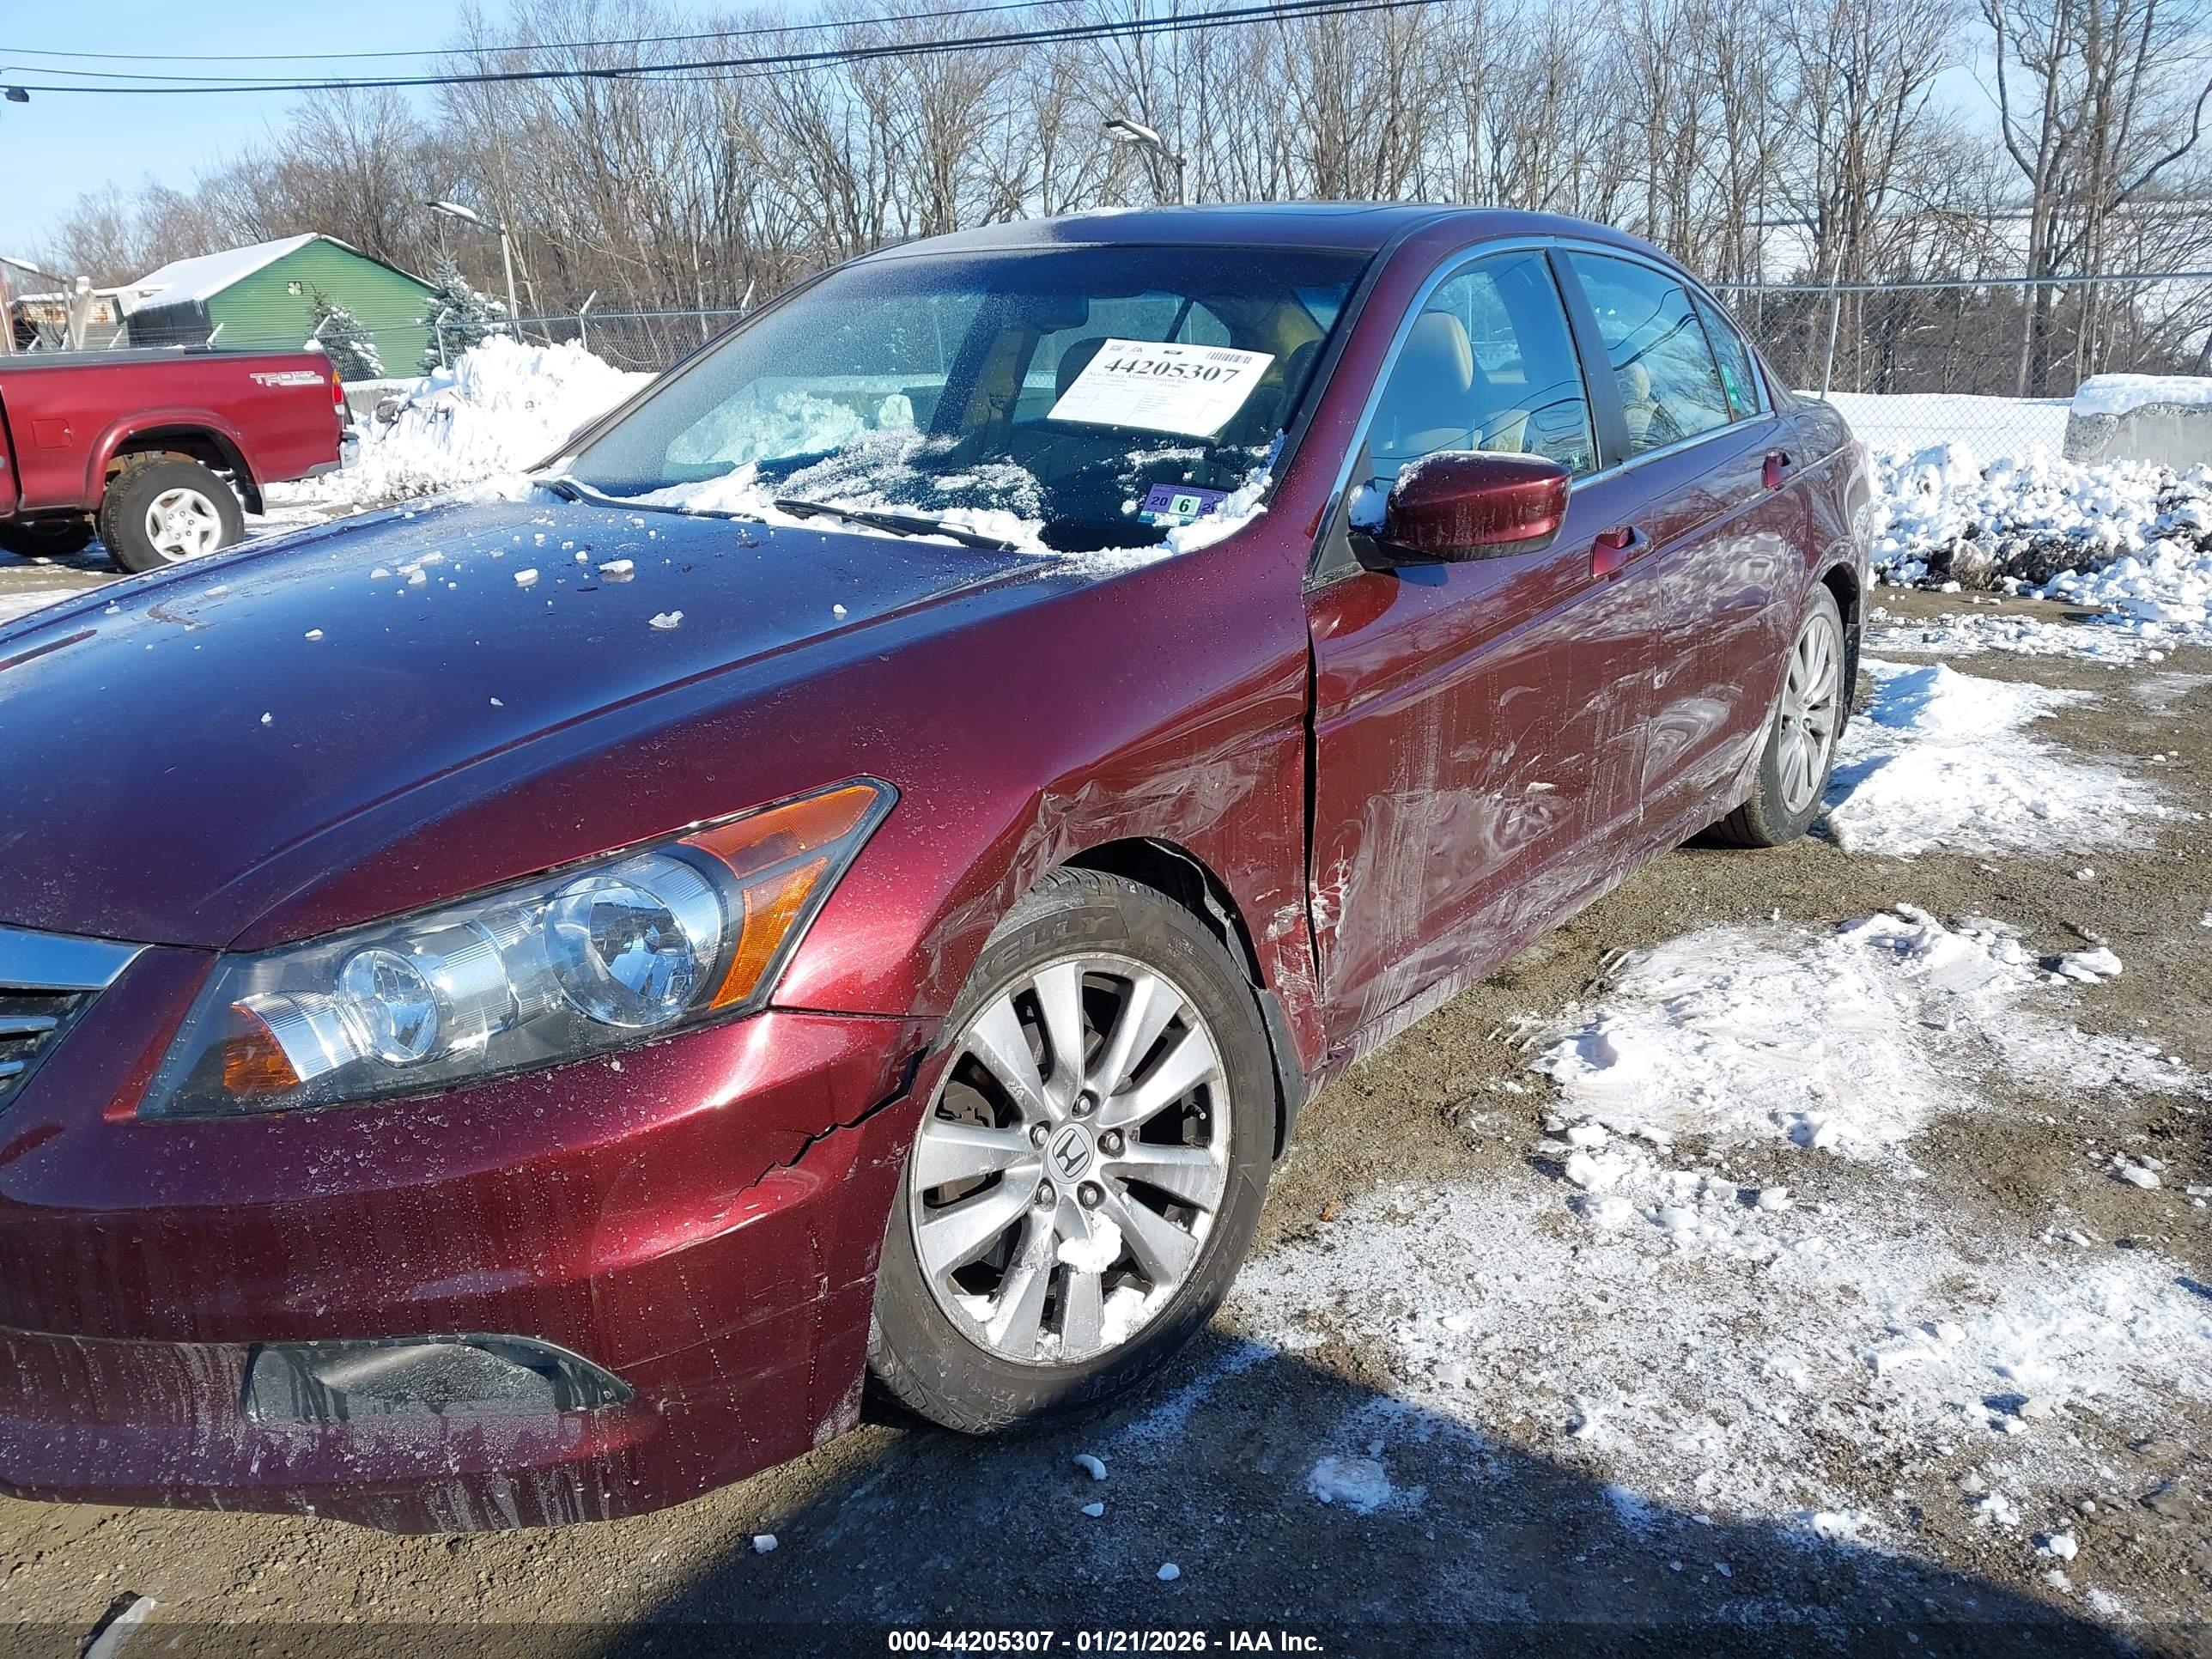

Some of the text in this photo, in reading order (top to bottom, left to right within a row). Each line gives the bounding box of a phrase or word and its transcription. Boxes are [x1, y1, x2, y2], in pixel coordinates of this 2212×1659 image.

[1104, 357, 1243, 384] 44205307
[1151, 495, 1169, 507] 20
[1178, 498, 1191, 513] 6
[975, 915, 1114, 984] KELLY
